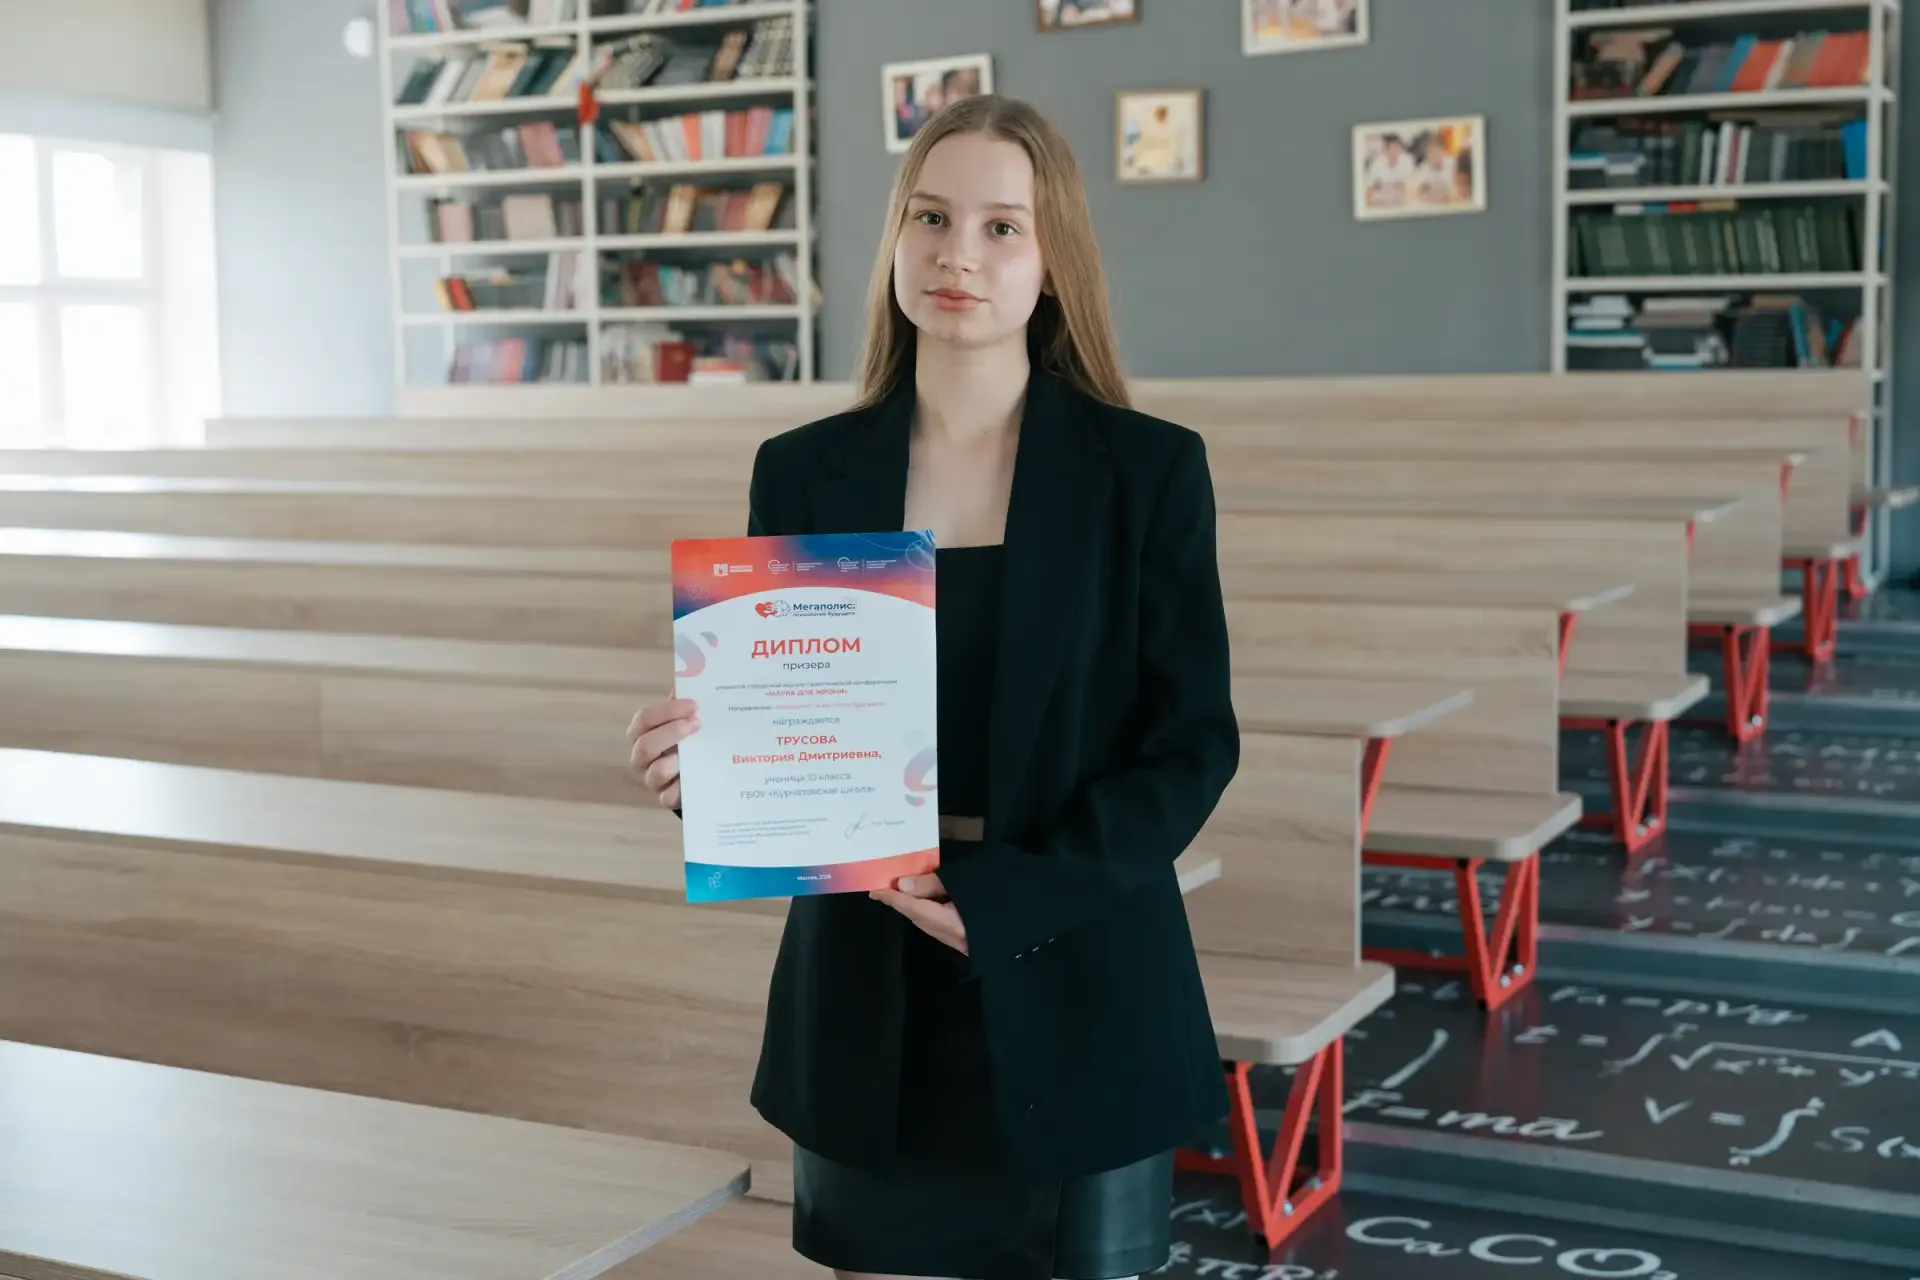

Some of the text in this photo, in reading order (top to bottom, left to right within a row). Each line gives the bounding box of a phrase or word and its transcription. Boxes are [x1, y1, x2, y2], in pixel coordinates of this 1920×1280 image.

[793, 603, 856, 611] Мегаполис:
[751, 637, 861, 659] ДИПЛОМ
[783, 661, 831, 672] призера
[773, 717, 840, 727] награждается
[776, 735, 838, 745] ТРУСОВА
[732, 750, 882, 764] Виктория Дмитриевна,
[764, 775, 805, 785] ученица
[807, 773, 817, 781] 10
[740, 786, 876, 799] ГБОУ «Курчатовская школа»
